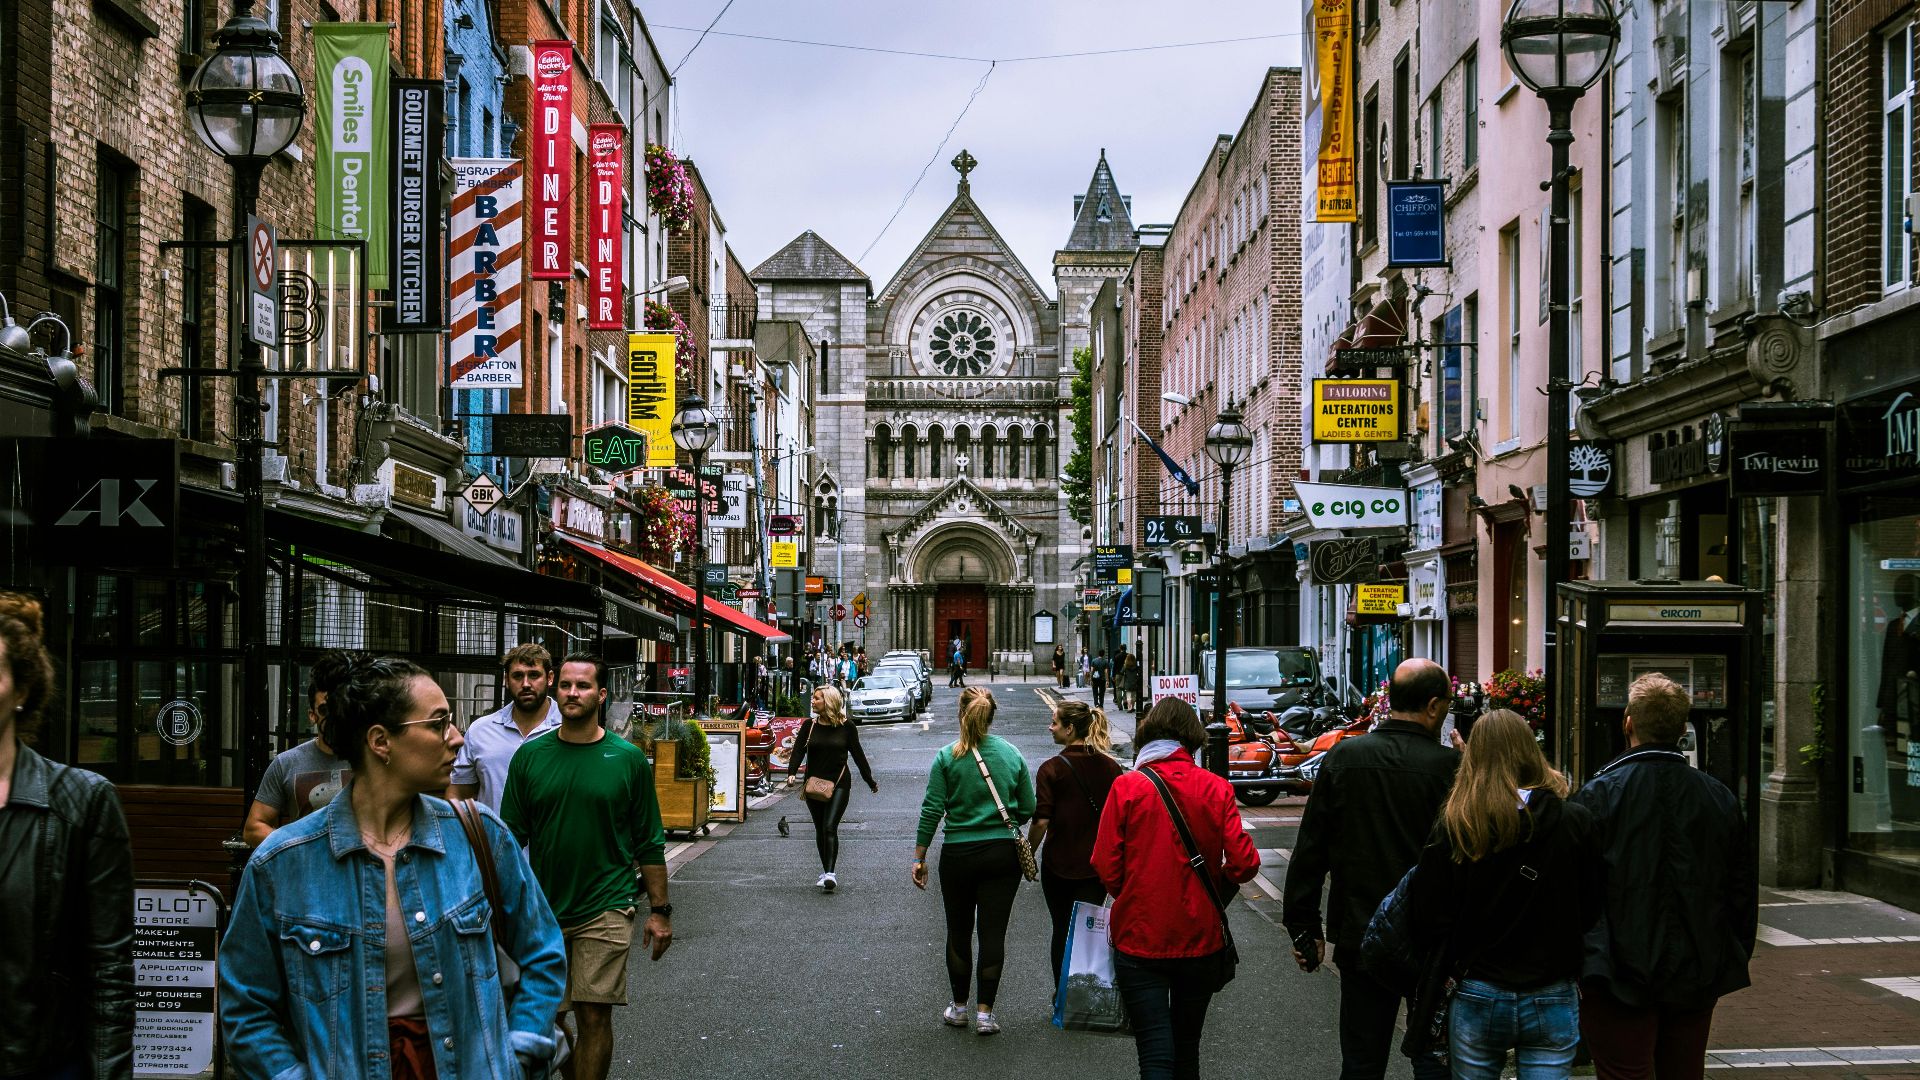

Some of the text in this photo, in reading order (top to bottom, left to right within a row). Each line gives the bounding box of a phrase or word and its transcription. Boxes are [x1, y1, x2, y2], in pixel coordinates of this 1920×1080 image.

[343, 69, 364, 144] Smiles
[466, 167, 518, 177] GRAFTON
[1320, 161, 1352, 184] CENTRE
[467, 180, 513, 189] BARBER
[543, 107, 559, 270] DINER
[341, 158, 363, 235] Dental
[402, 89, 423, 323] GOURMET BURGER KITCHEN
[1394, 204, 1437, 212] CHIFFON
[598, 181, 613, 321] DINER
[473, 195, 500, 358] BARBER
[464, 361, 517, 370] GRAFTON
[467, 374, 512, 382] BARBER
[630, 350, 669, 420] GOTHAM
[1327, 387, 1388, 398] TAILORING
[1322, 404, 1394, 415] ALTERATIONS
[1337, 417, 1378, 428] CENTRE
[1321, 430, 1393, 438] LADIES & GENTS
[589, 435, 642, 464] EAT
[723, 481, 742, 492] METIC
[471, 488, 494, 501] GBK
[1311, 502, 1325, 516] e
[1330, 499, 1366, 519] cig
[1370, 498, 1400, 514] co
[1159, 677, 1190, 689] DO NOT
[137, 897, 208, 913] GLOT
[133, 916, 147, 924] RO
[132, 950, 175, 958] EEMABLE
[140, 963, 204, 971] APPLICATION
